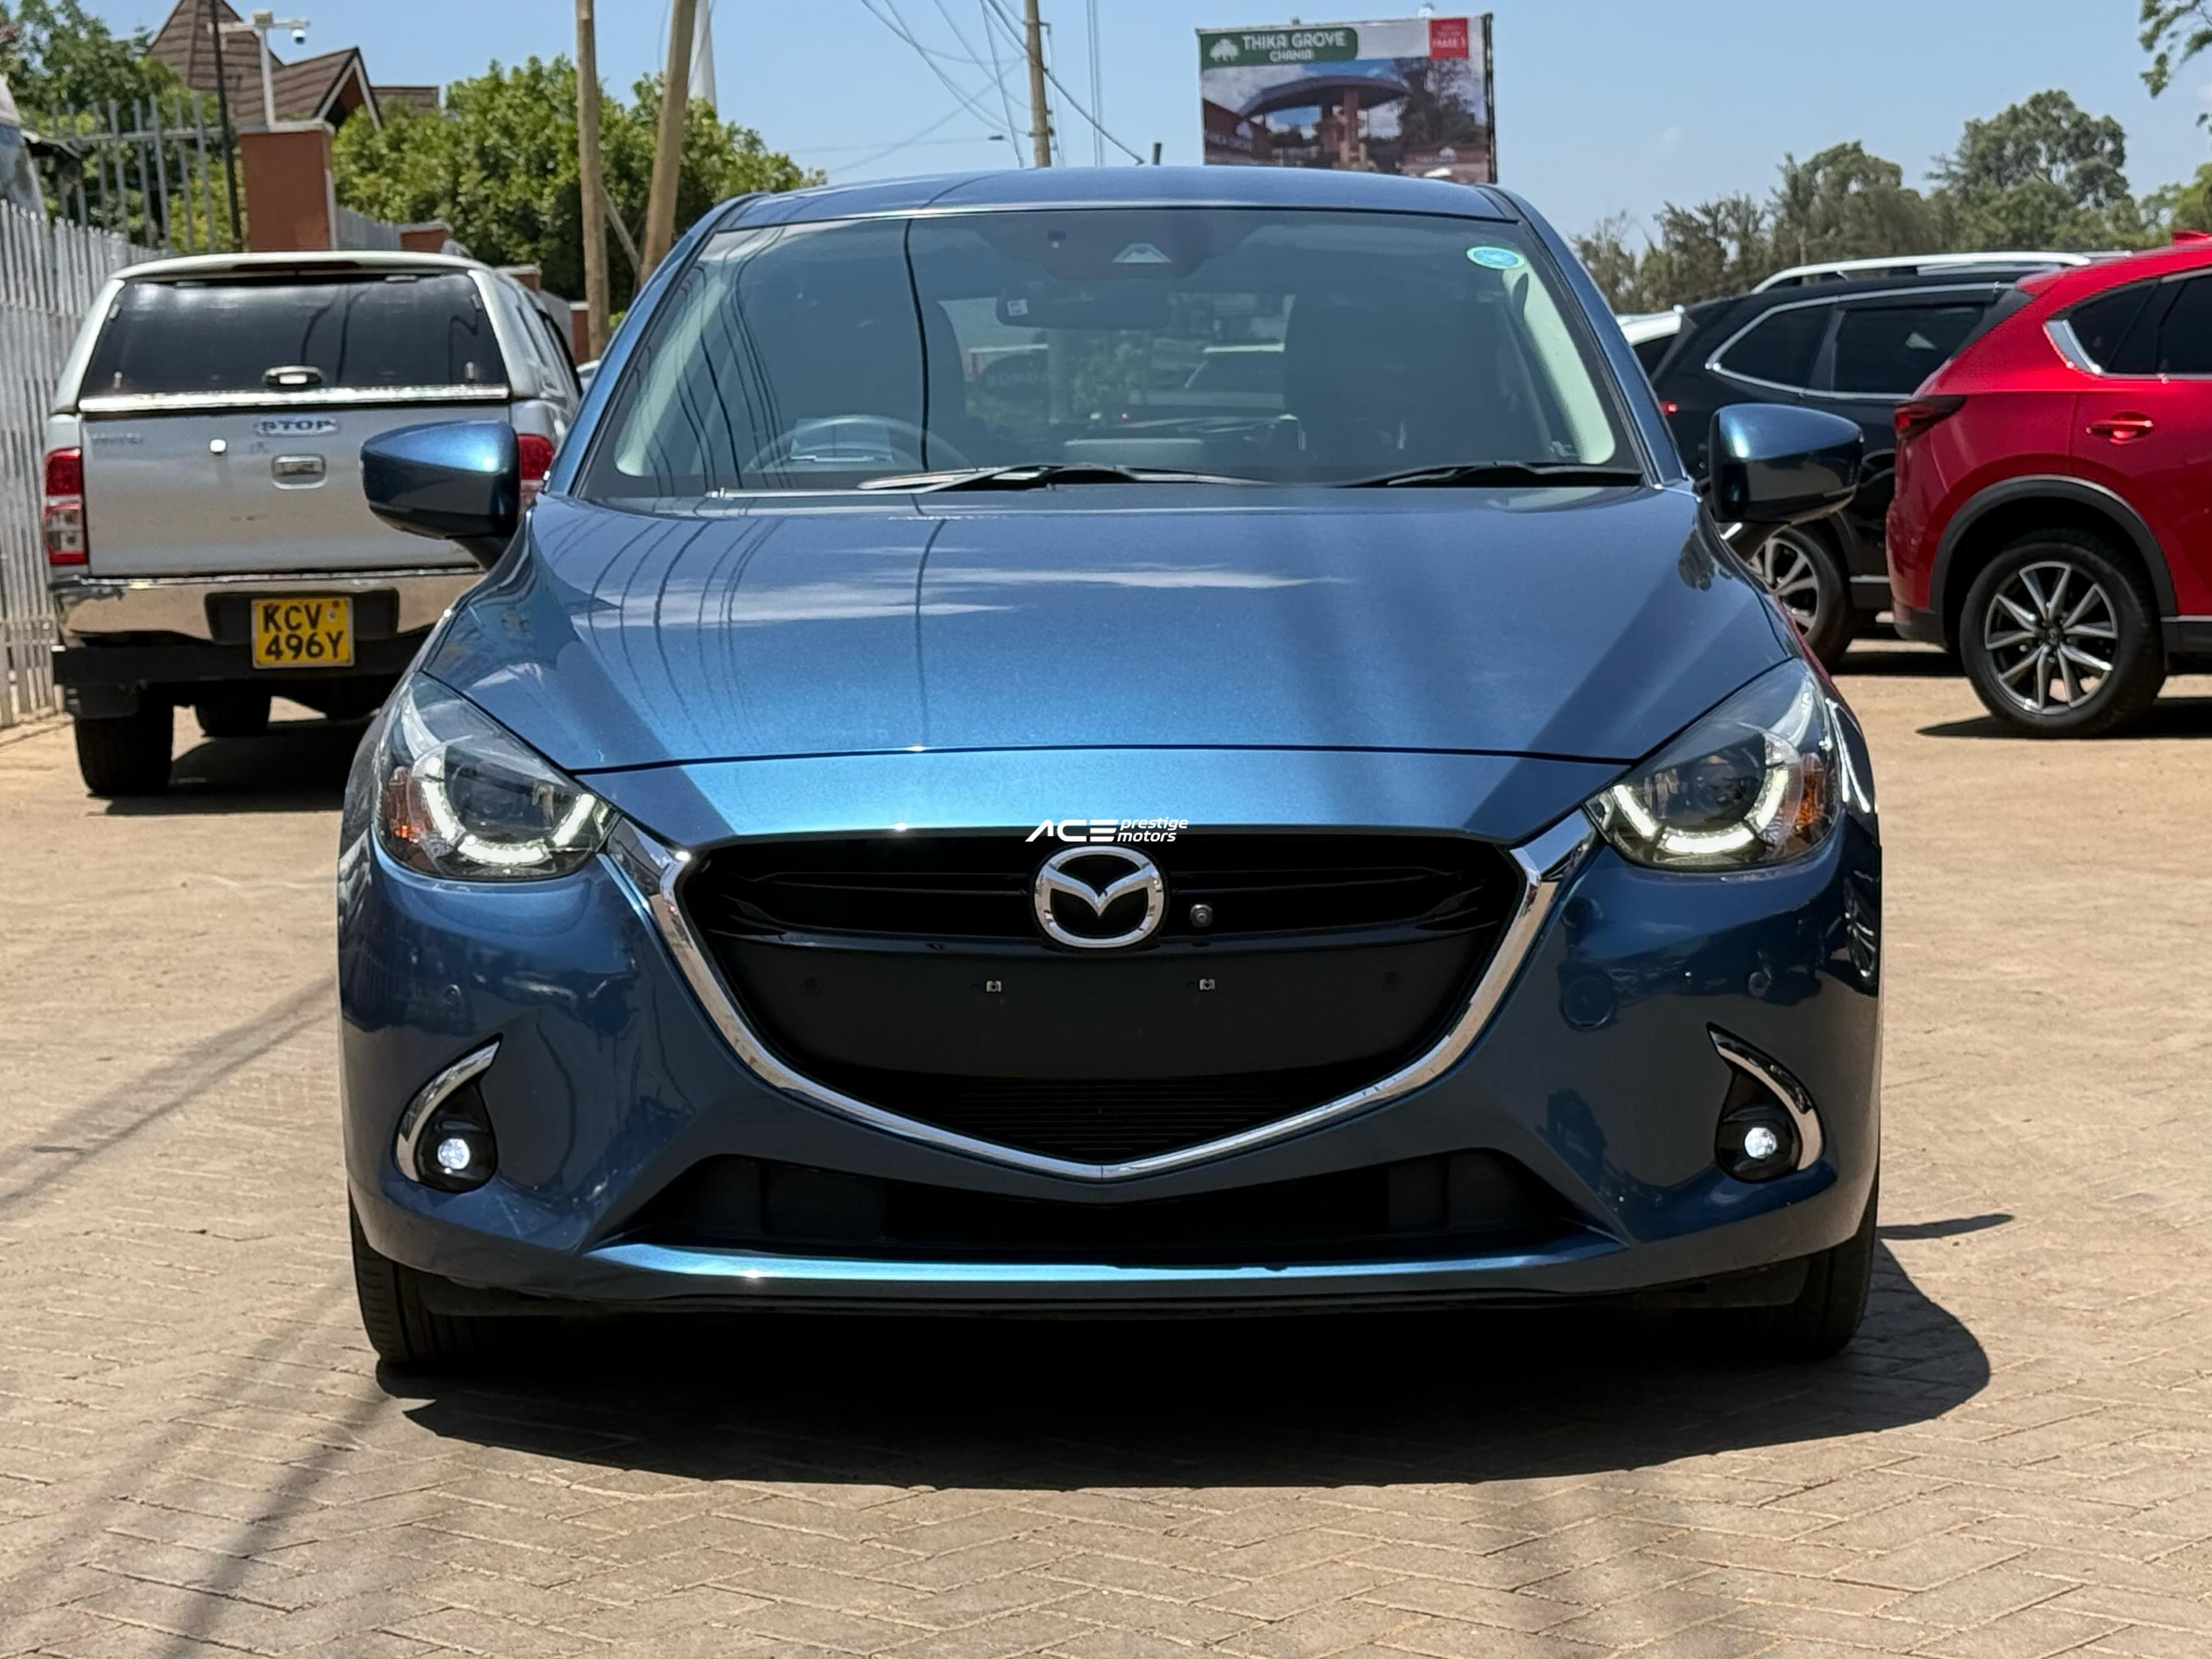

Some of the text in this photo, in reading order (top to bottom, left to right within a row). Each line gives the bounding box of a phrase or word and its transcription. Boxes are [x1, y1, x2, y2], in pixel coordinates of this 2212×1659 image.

[1242, 31, 1346, 51] THIKA GROVE
[1269, 49, 1314, 63] CHANIA
[260, 420, 336, 431] STOP
[262, 603, 322, 633] KCV
[264, 630, 344, 660] 496Y
